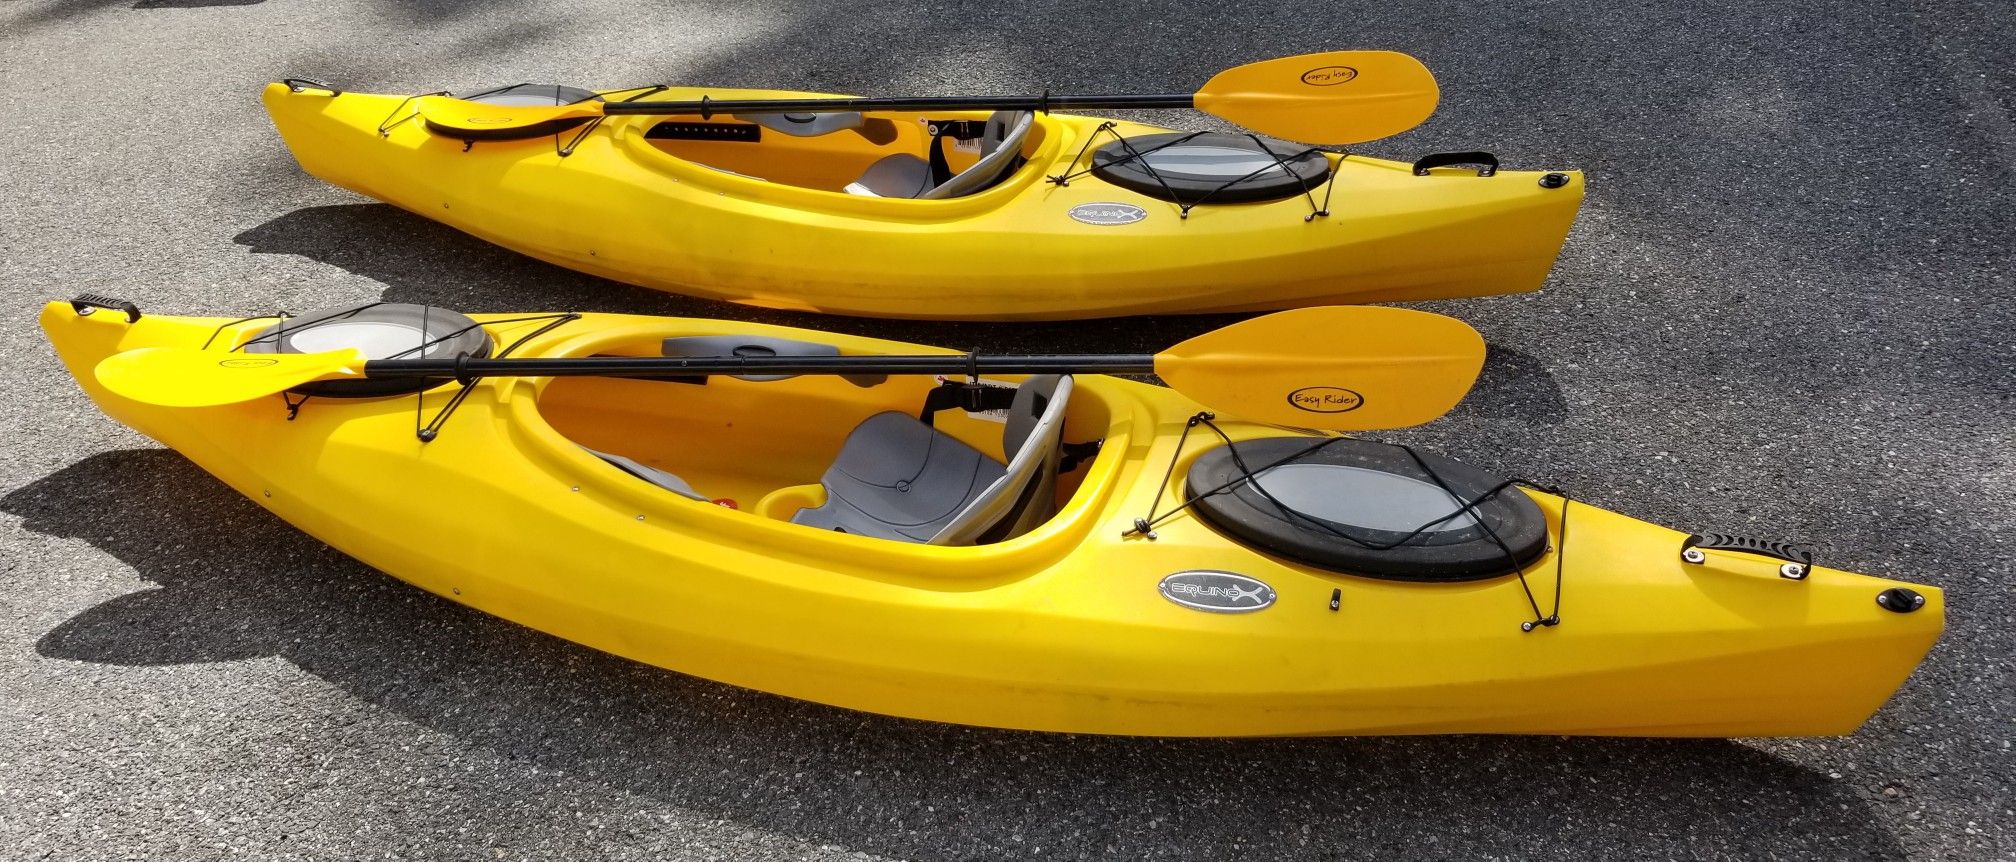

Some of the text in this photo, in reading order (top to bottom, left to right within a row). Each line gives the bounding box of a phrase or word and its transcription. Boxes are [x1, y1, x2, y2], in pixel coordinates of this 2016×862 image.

[1307, 69, 1353, 81] Easy Rider
[1295, 393, 1358, 408] Easy Rider
[1171, 582, 1263, 604] EQUINOX
